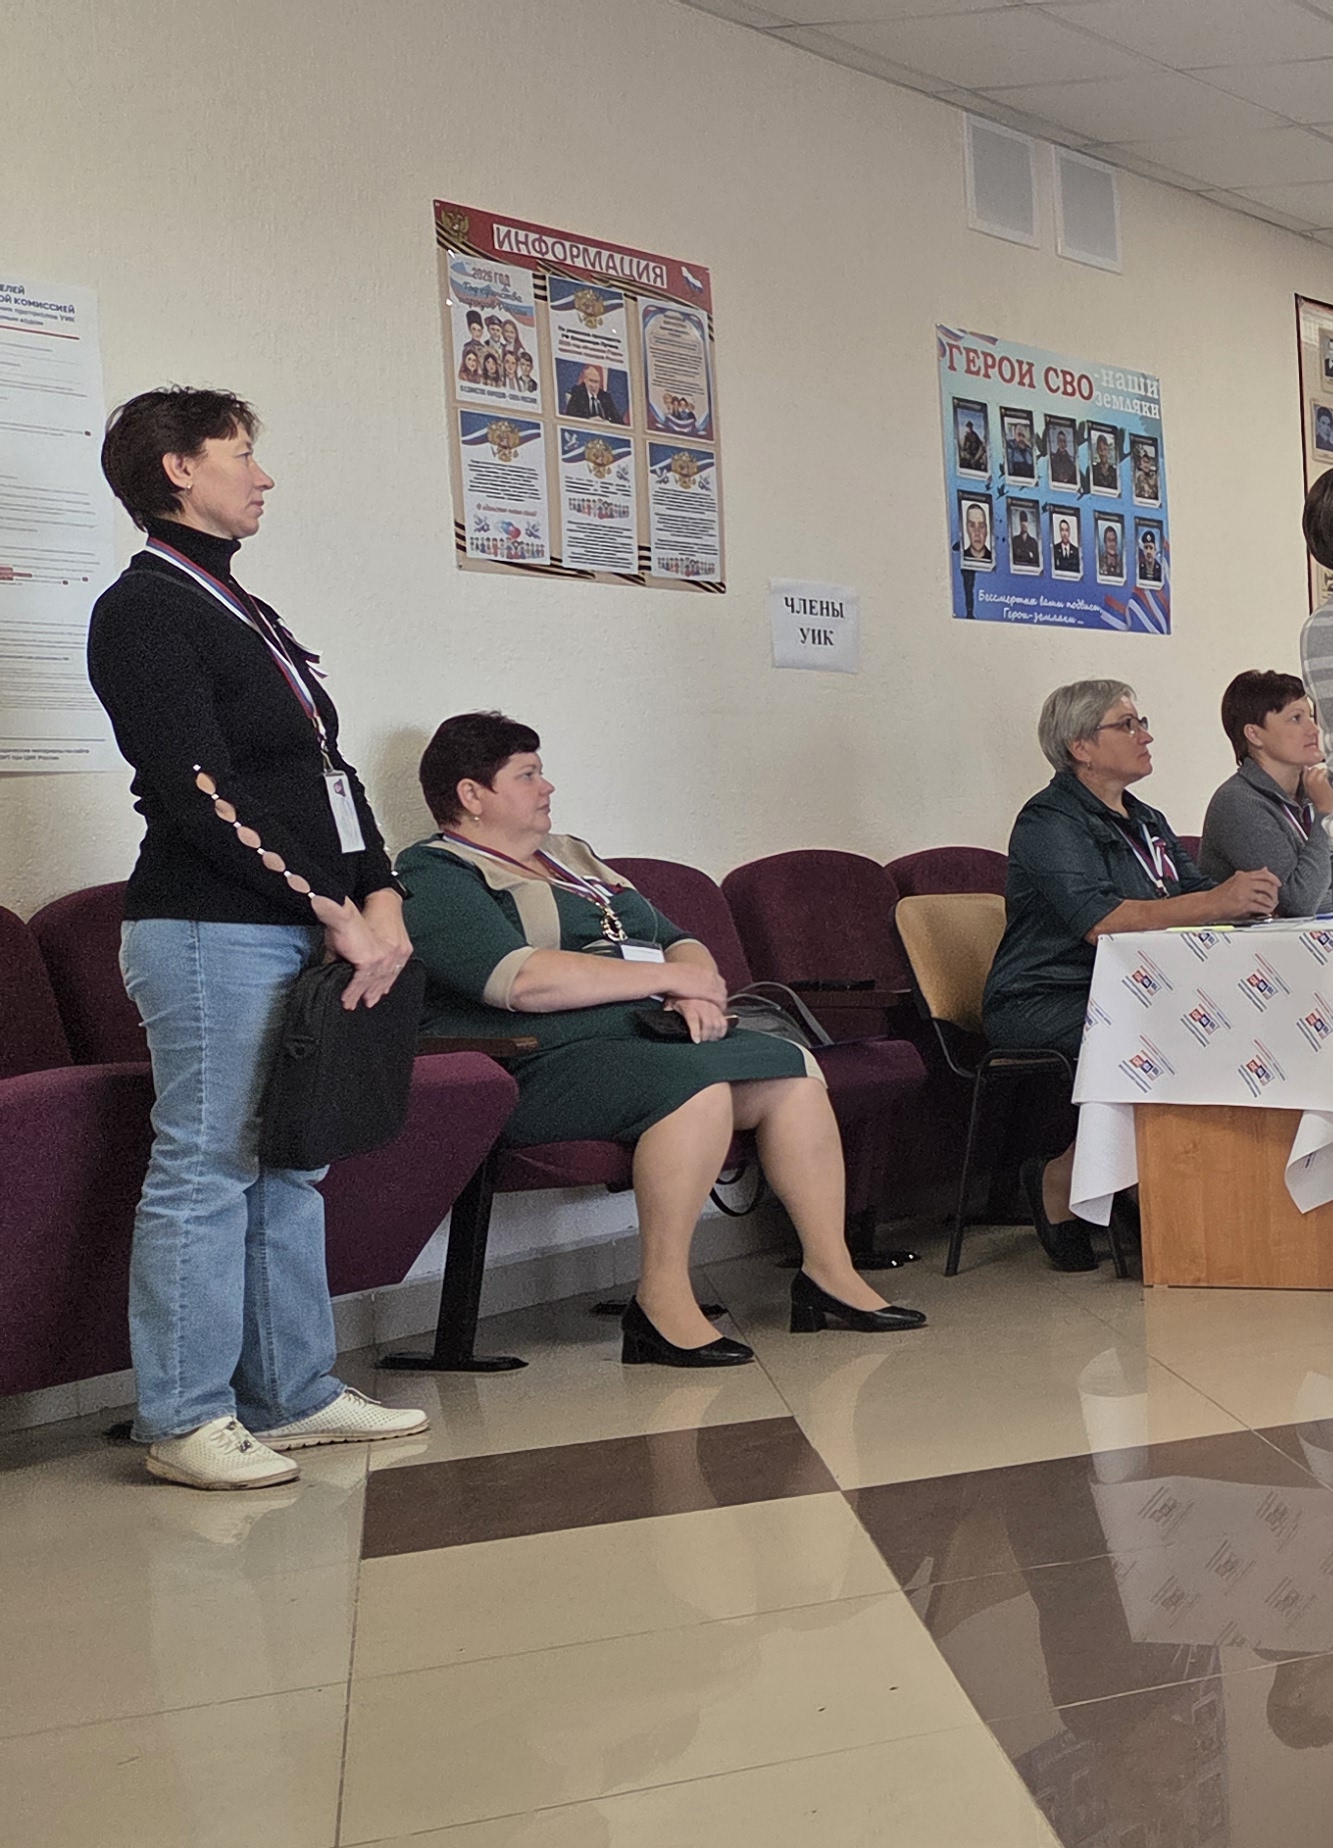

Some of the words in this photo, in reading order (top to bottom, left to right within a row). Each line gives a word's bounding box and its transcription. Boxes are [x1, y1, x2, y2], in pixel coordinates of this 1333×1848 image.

[496, 226, 665, 287] ИНФОРМАЦИЯ
[14, 297, 75, 314] КОМИССИЕЙ
[946, 342, 1036, 389] ГЕРОИ
[1044, 365, 1094, 401] СВО
[784, 596, 844, 618] ЧЛЕНЫ
[800, 627, 834, 646] УИК
